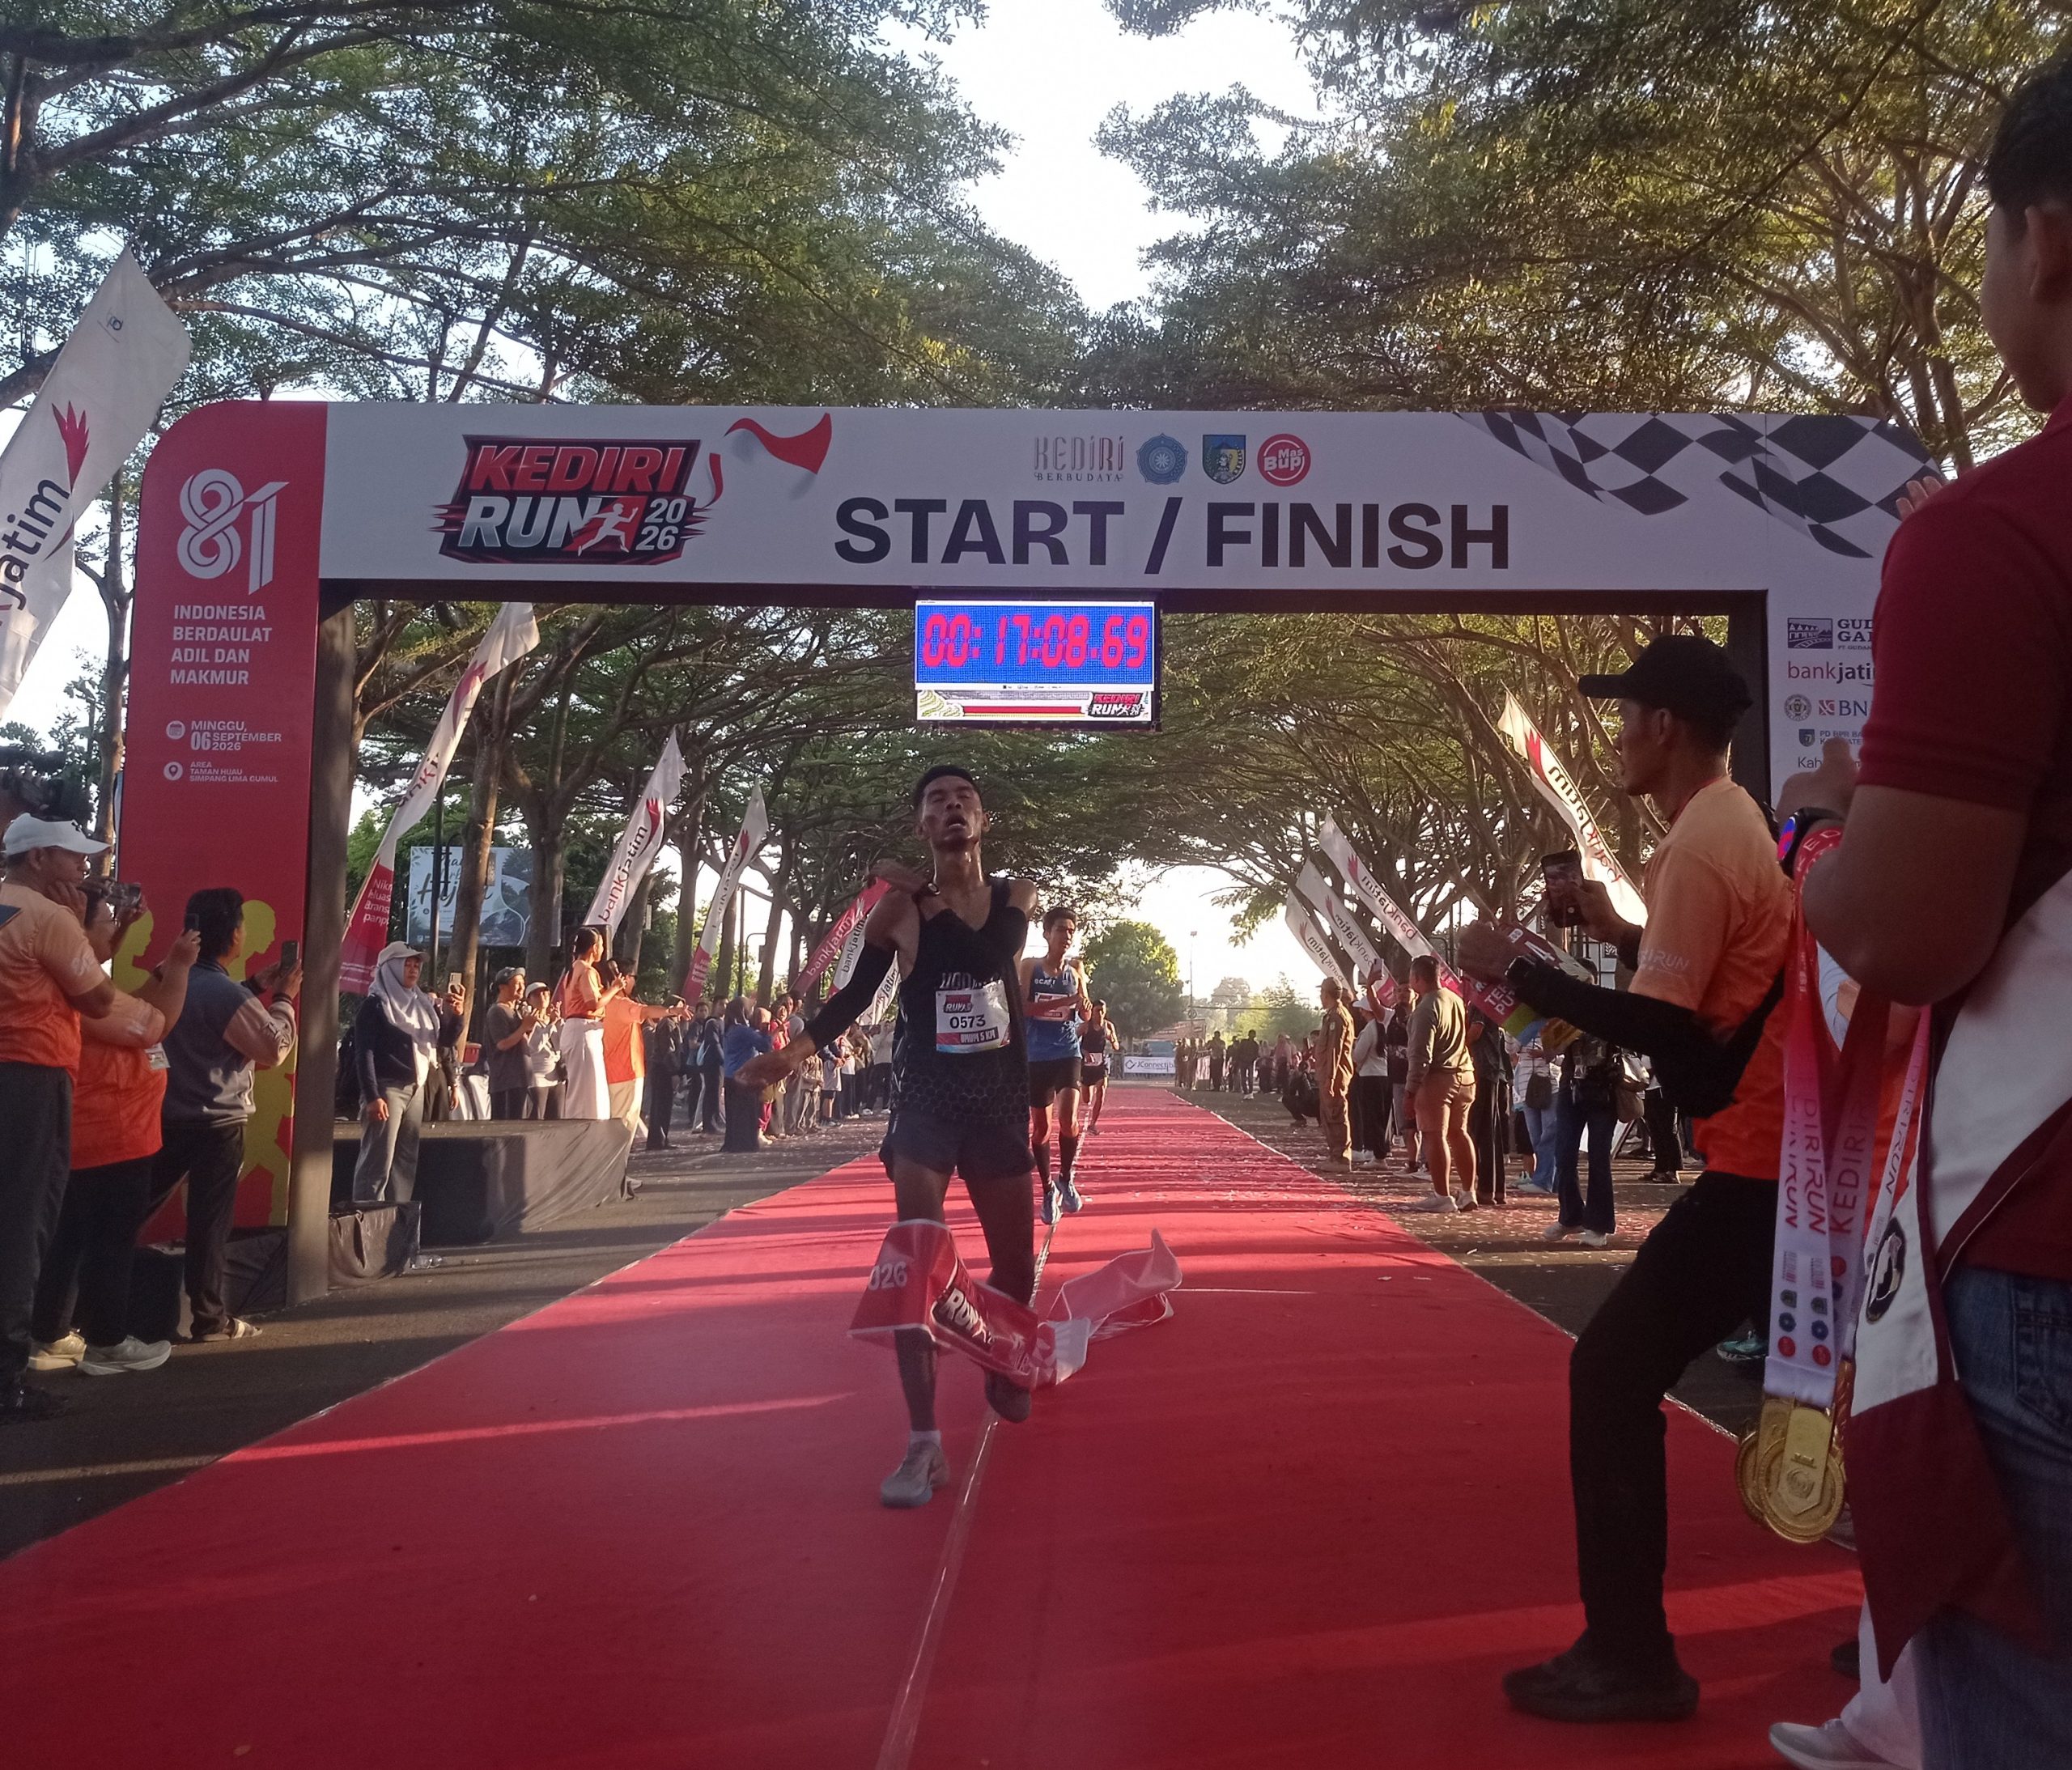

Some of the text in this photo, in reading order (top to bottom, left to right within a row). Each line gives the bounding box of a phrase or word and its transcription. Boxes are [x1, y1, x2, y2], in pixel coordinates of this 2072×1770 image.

[1278, 448, 1303, 460] Mas
[469, 444, 687, 493] KEDIRI
[1263, 456, 1301, 472] Bup
[1035, 472, 1123, 482] BERBUDAYA
[457, 495, 603, 549] RUN
[176, 468, 290, 596] 81
[834, 496, 1509, 575] START / FINISH
[0, 479, 70, 611] jatim
[173, 604, 265, 621] INDONESIA
[172, 626, 273, 643] BERDAULAT
[171, 647, 250, 664] ADIL DAN
[170, 669, 249, 685] MAKMUR
[1788, 660, 1875, 684] bankjati
[1839, 700, 1868, 716] BN
[191, 720, 247, 732] MINGGU,
[190, 731, 282, 751] 06 SEPTEMBER
[212, 742, 241, 751] 2026
[597, 826, 648, 923] bankjatim
[841, 919, 866, 974] bankjatim
[949, 1014, 986, 1029] 0573
[961, 1029, 996, 1043] UMUM 5 KM
[868, 1261, 907, 1291] 026
